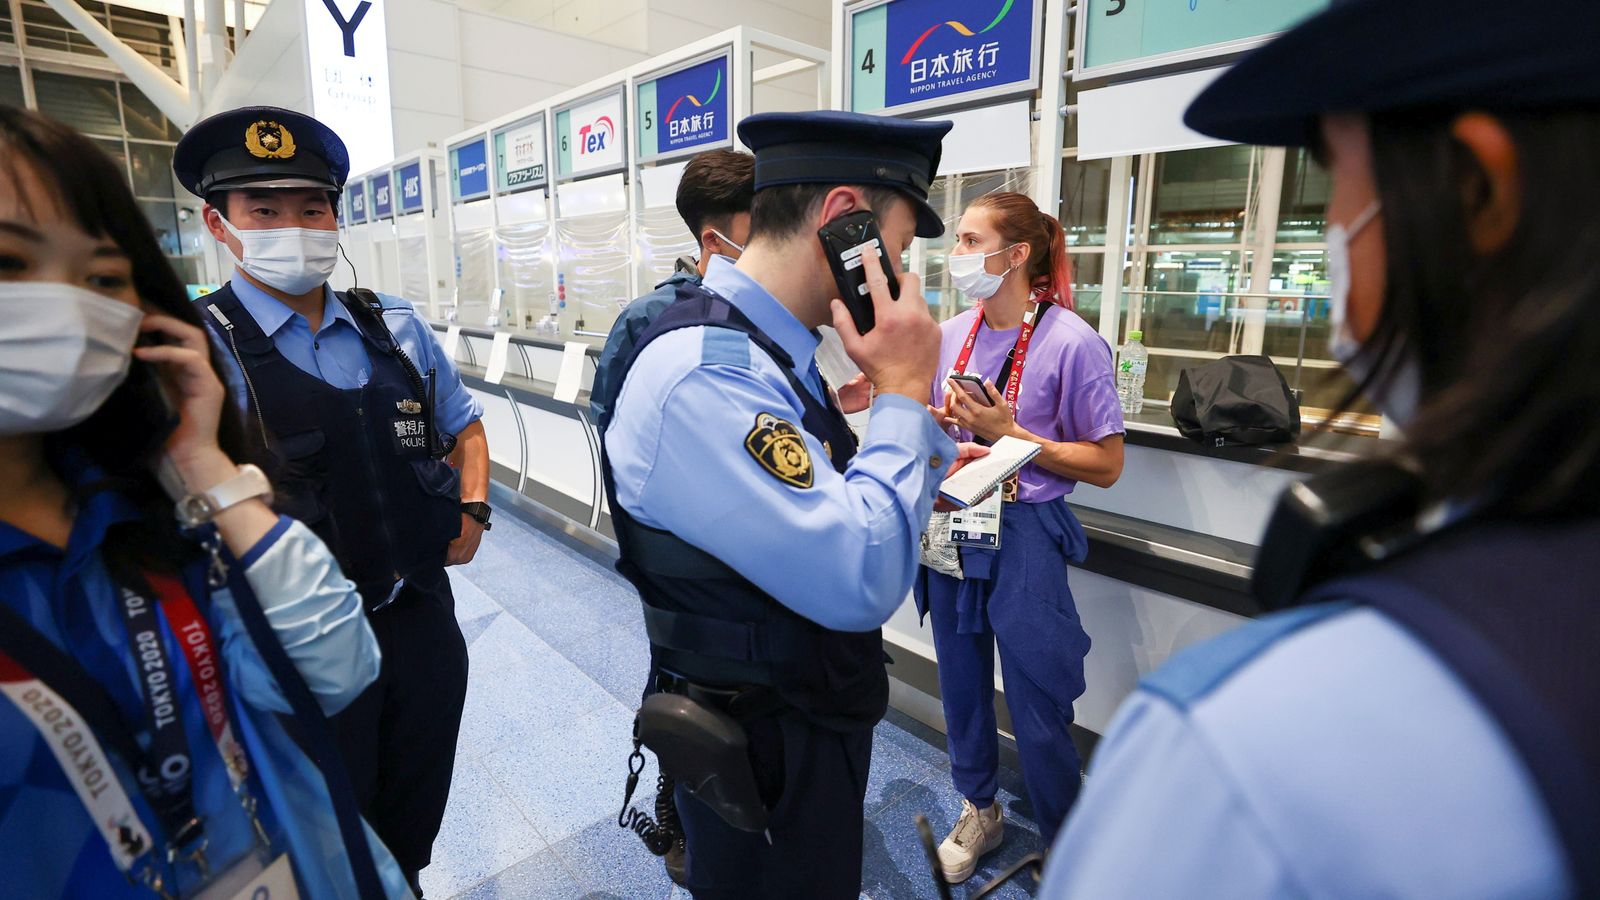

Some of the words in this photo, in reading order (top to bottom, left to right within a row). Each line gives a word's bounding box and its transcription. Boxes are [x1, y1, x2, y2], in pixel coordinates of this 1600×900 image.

[322, 0, 372, 57] Y
[861, 48, 876, 74] 4
[910, 41, 1000, 84] 日本旅行
[910, 82, 936, 94] NIPPON
[937, 77, 964, 88] TRAVEL
[965, 69, 998, 83] AGENCY
[645, 110, 652, 130] 5
[669, 111, 714, 137] 日本旅行
[561, 135, 567, 151] 6
[579, 124, 606, 155] Tex
[394, 420, 426, 437] 警視庁
[400, 437, 426, 448] POLICE
[952, 532, 959, 540] A
[136, 630, 164, 671] 2020
[182, 619, 216, 680] TOKYO
[203, 680, 224, 725] 2020
[22, 687, 74, 735] 2020
[147, 671, 177, 730] TOKYO
[62, 732, 110, 800] TOKYO
